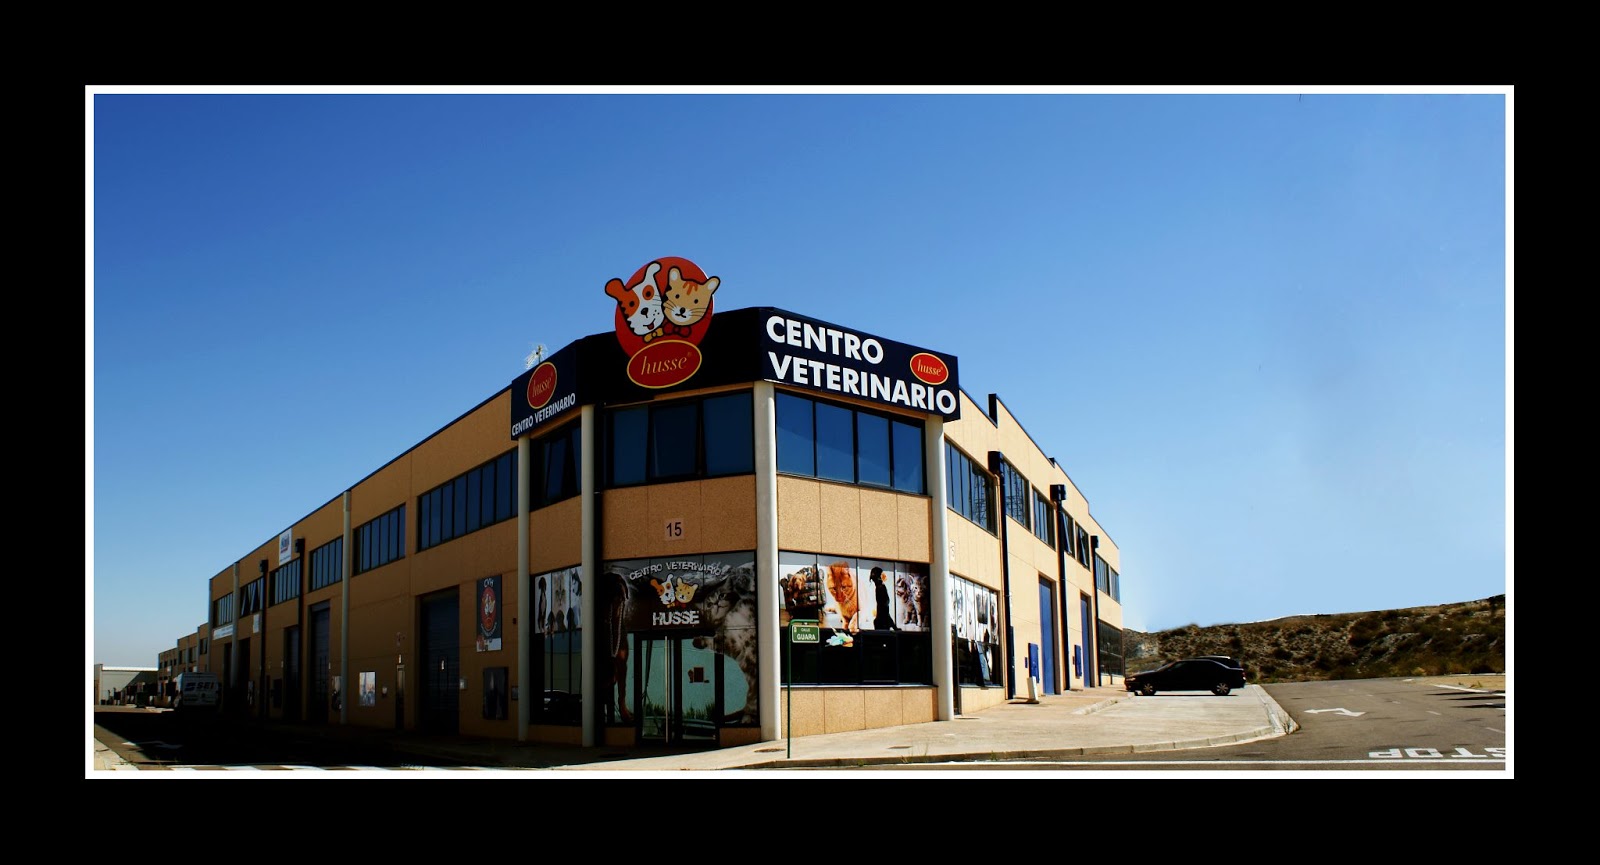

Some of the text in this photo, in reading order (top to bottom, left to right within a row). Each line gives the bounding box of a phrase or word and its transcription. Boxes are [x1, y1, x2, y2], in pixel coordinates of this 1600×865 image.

[766, 315, 884, 365] CENTRO
[641, 355, 688, 376] husse
[917, 359, 942, 377] husse
[532, 377, 552, 398] husse
[768, 351, 957, 415] VETERINARIO
[511, 392, 576, 437] CENTRO VETERINARIO
[666, 521, 682, 538] 15
[629, 561, 722, 581] CENTRO VETERINARIO
[652, 610, 700, 626] HUSSE
[796, 633, 816, 641] GUARA
